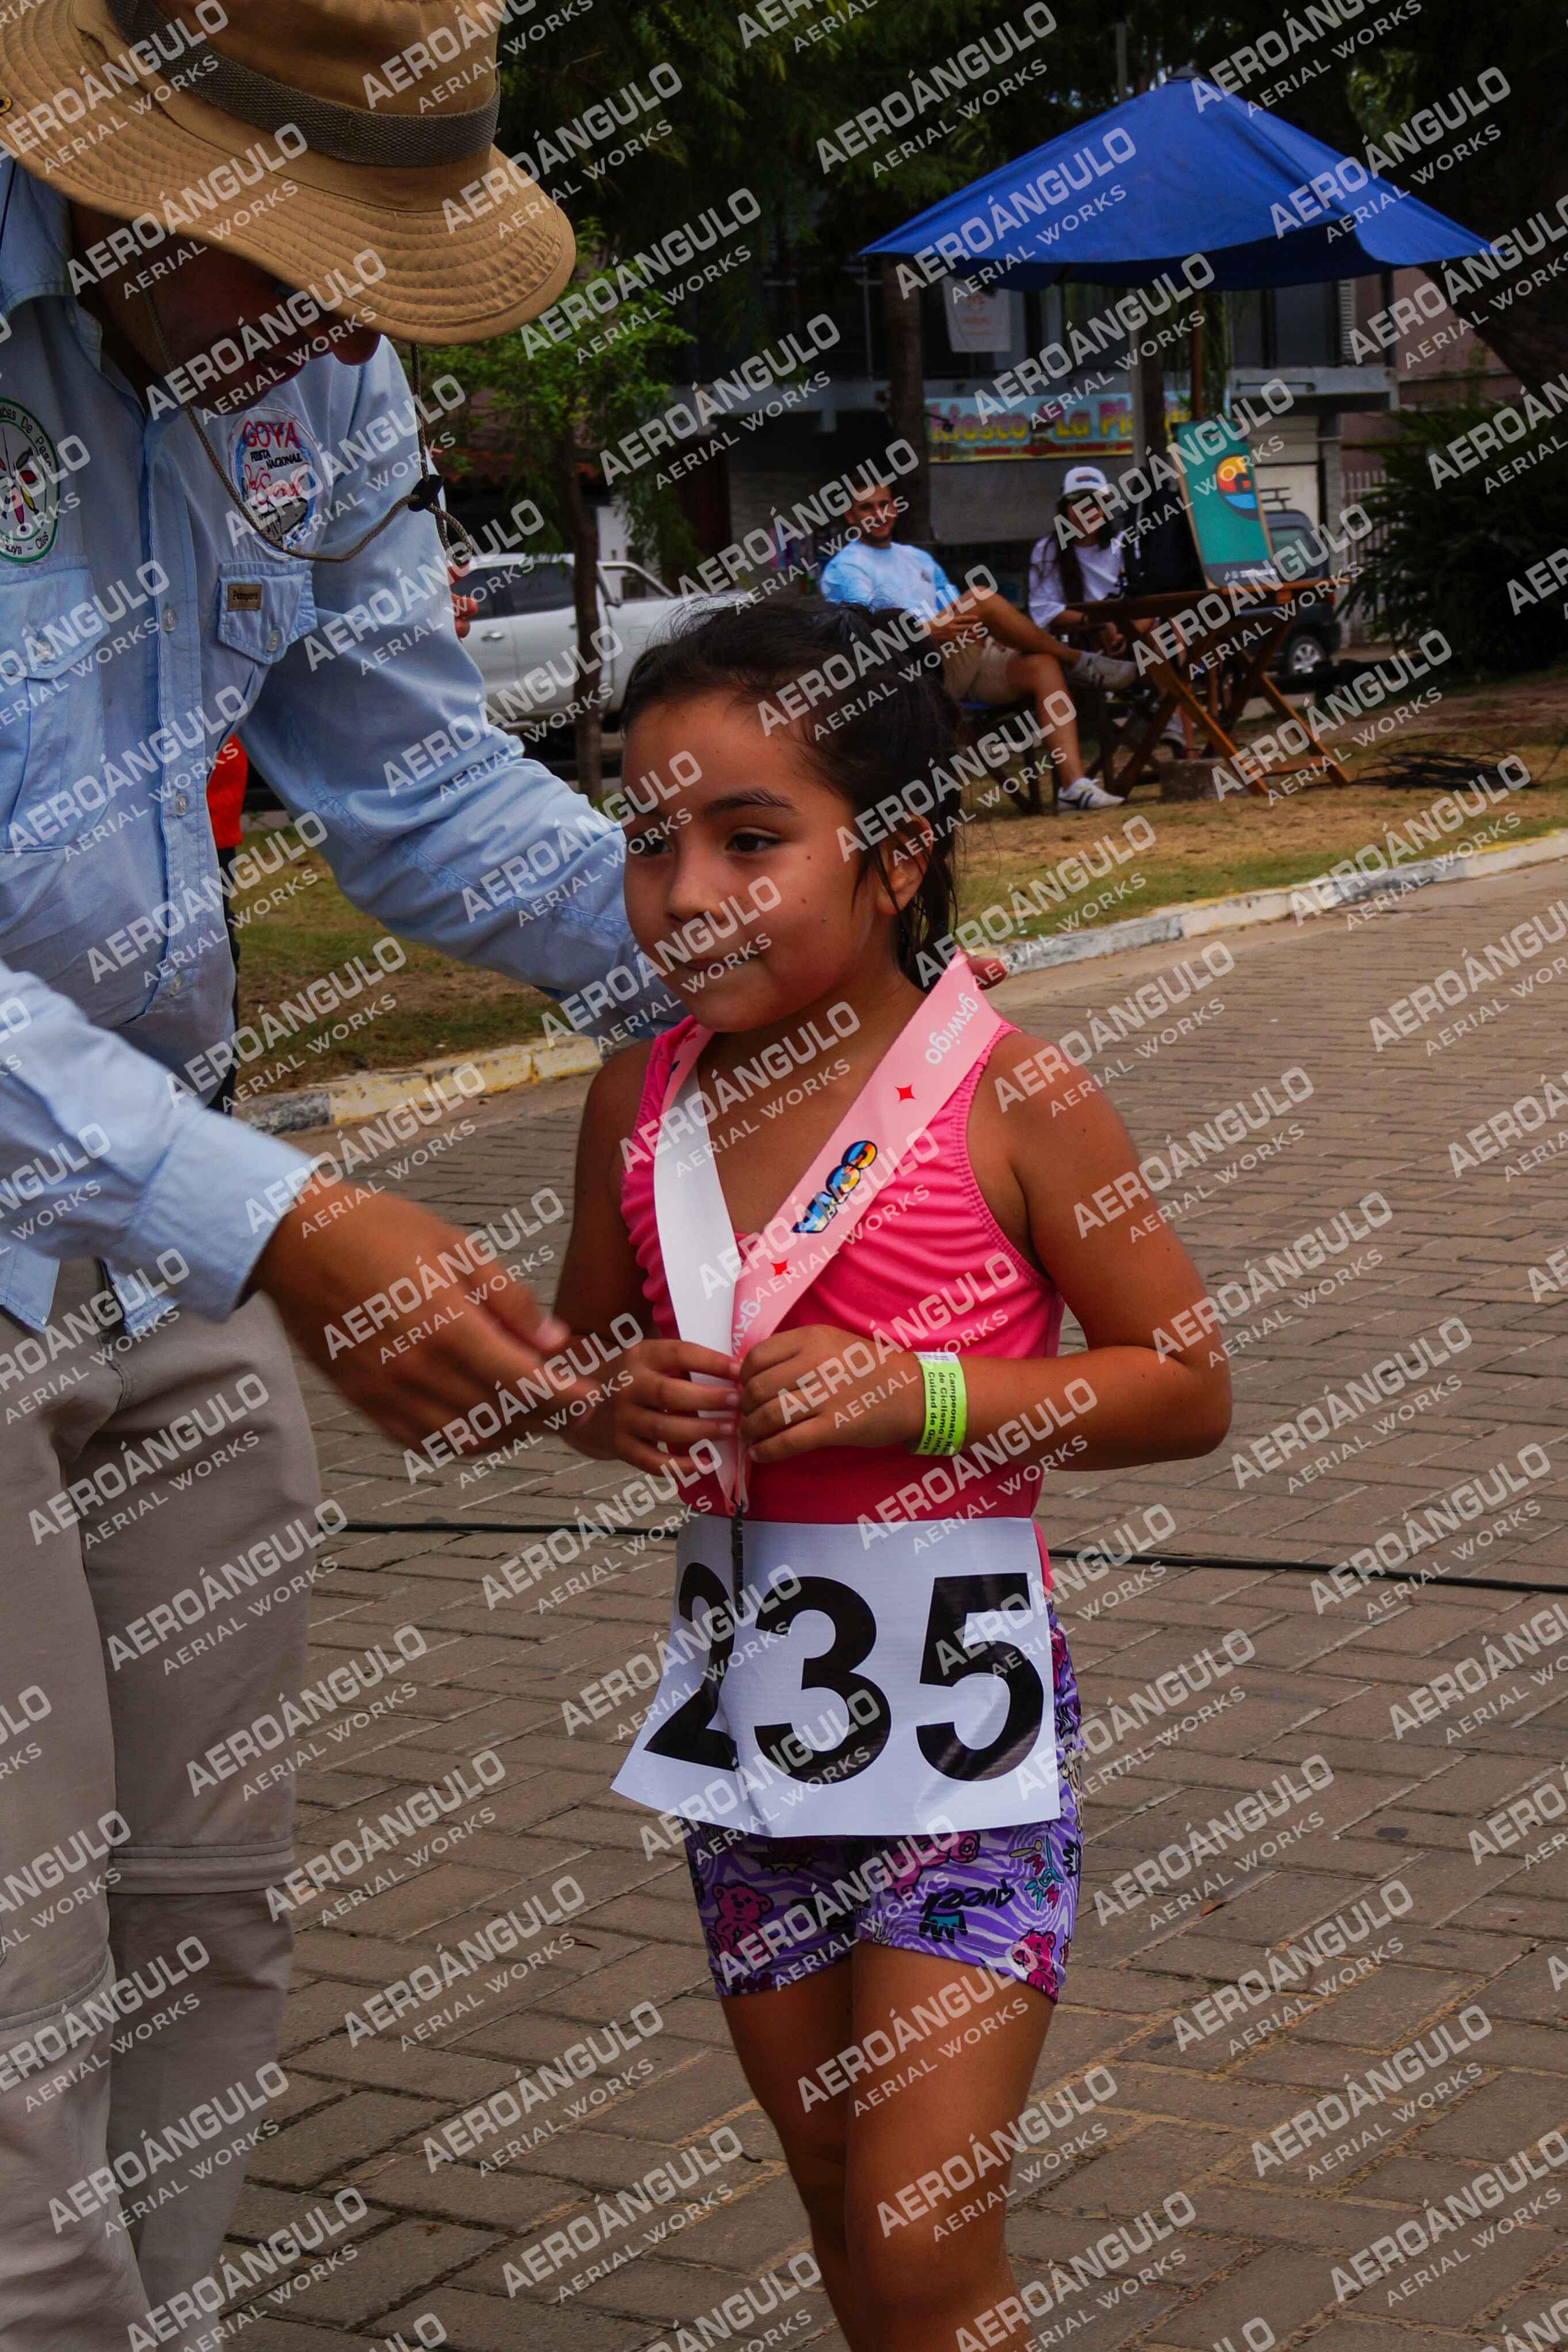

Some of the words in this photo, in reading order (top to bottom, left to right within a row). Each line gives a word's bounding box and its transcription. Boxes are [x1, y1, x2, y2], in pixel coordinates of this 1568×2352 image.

[21, 416, 33, 433] De
[242, 421, 301, 449] GOYA
[930, 402, 1027, 441] Kiosco
[266, 453, 303, 470] NACIONAL
[928, 1372, 937, 1409] Cuidad
[938, 1372, 946, 1384] de
[930, 1412, 938, 1426] de
[939, 1387, 948, 1434] Ciclismo
[948, 1372, 957, 1438] Campeonato
[642, 1562, 1045, 1784] 235
